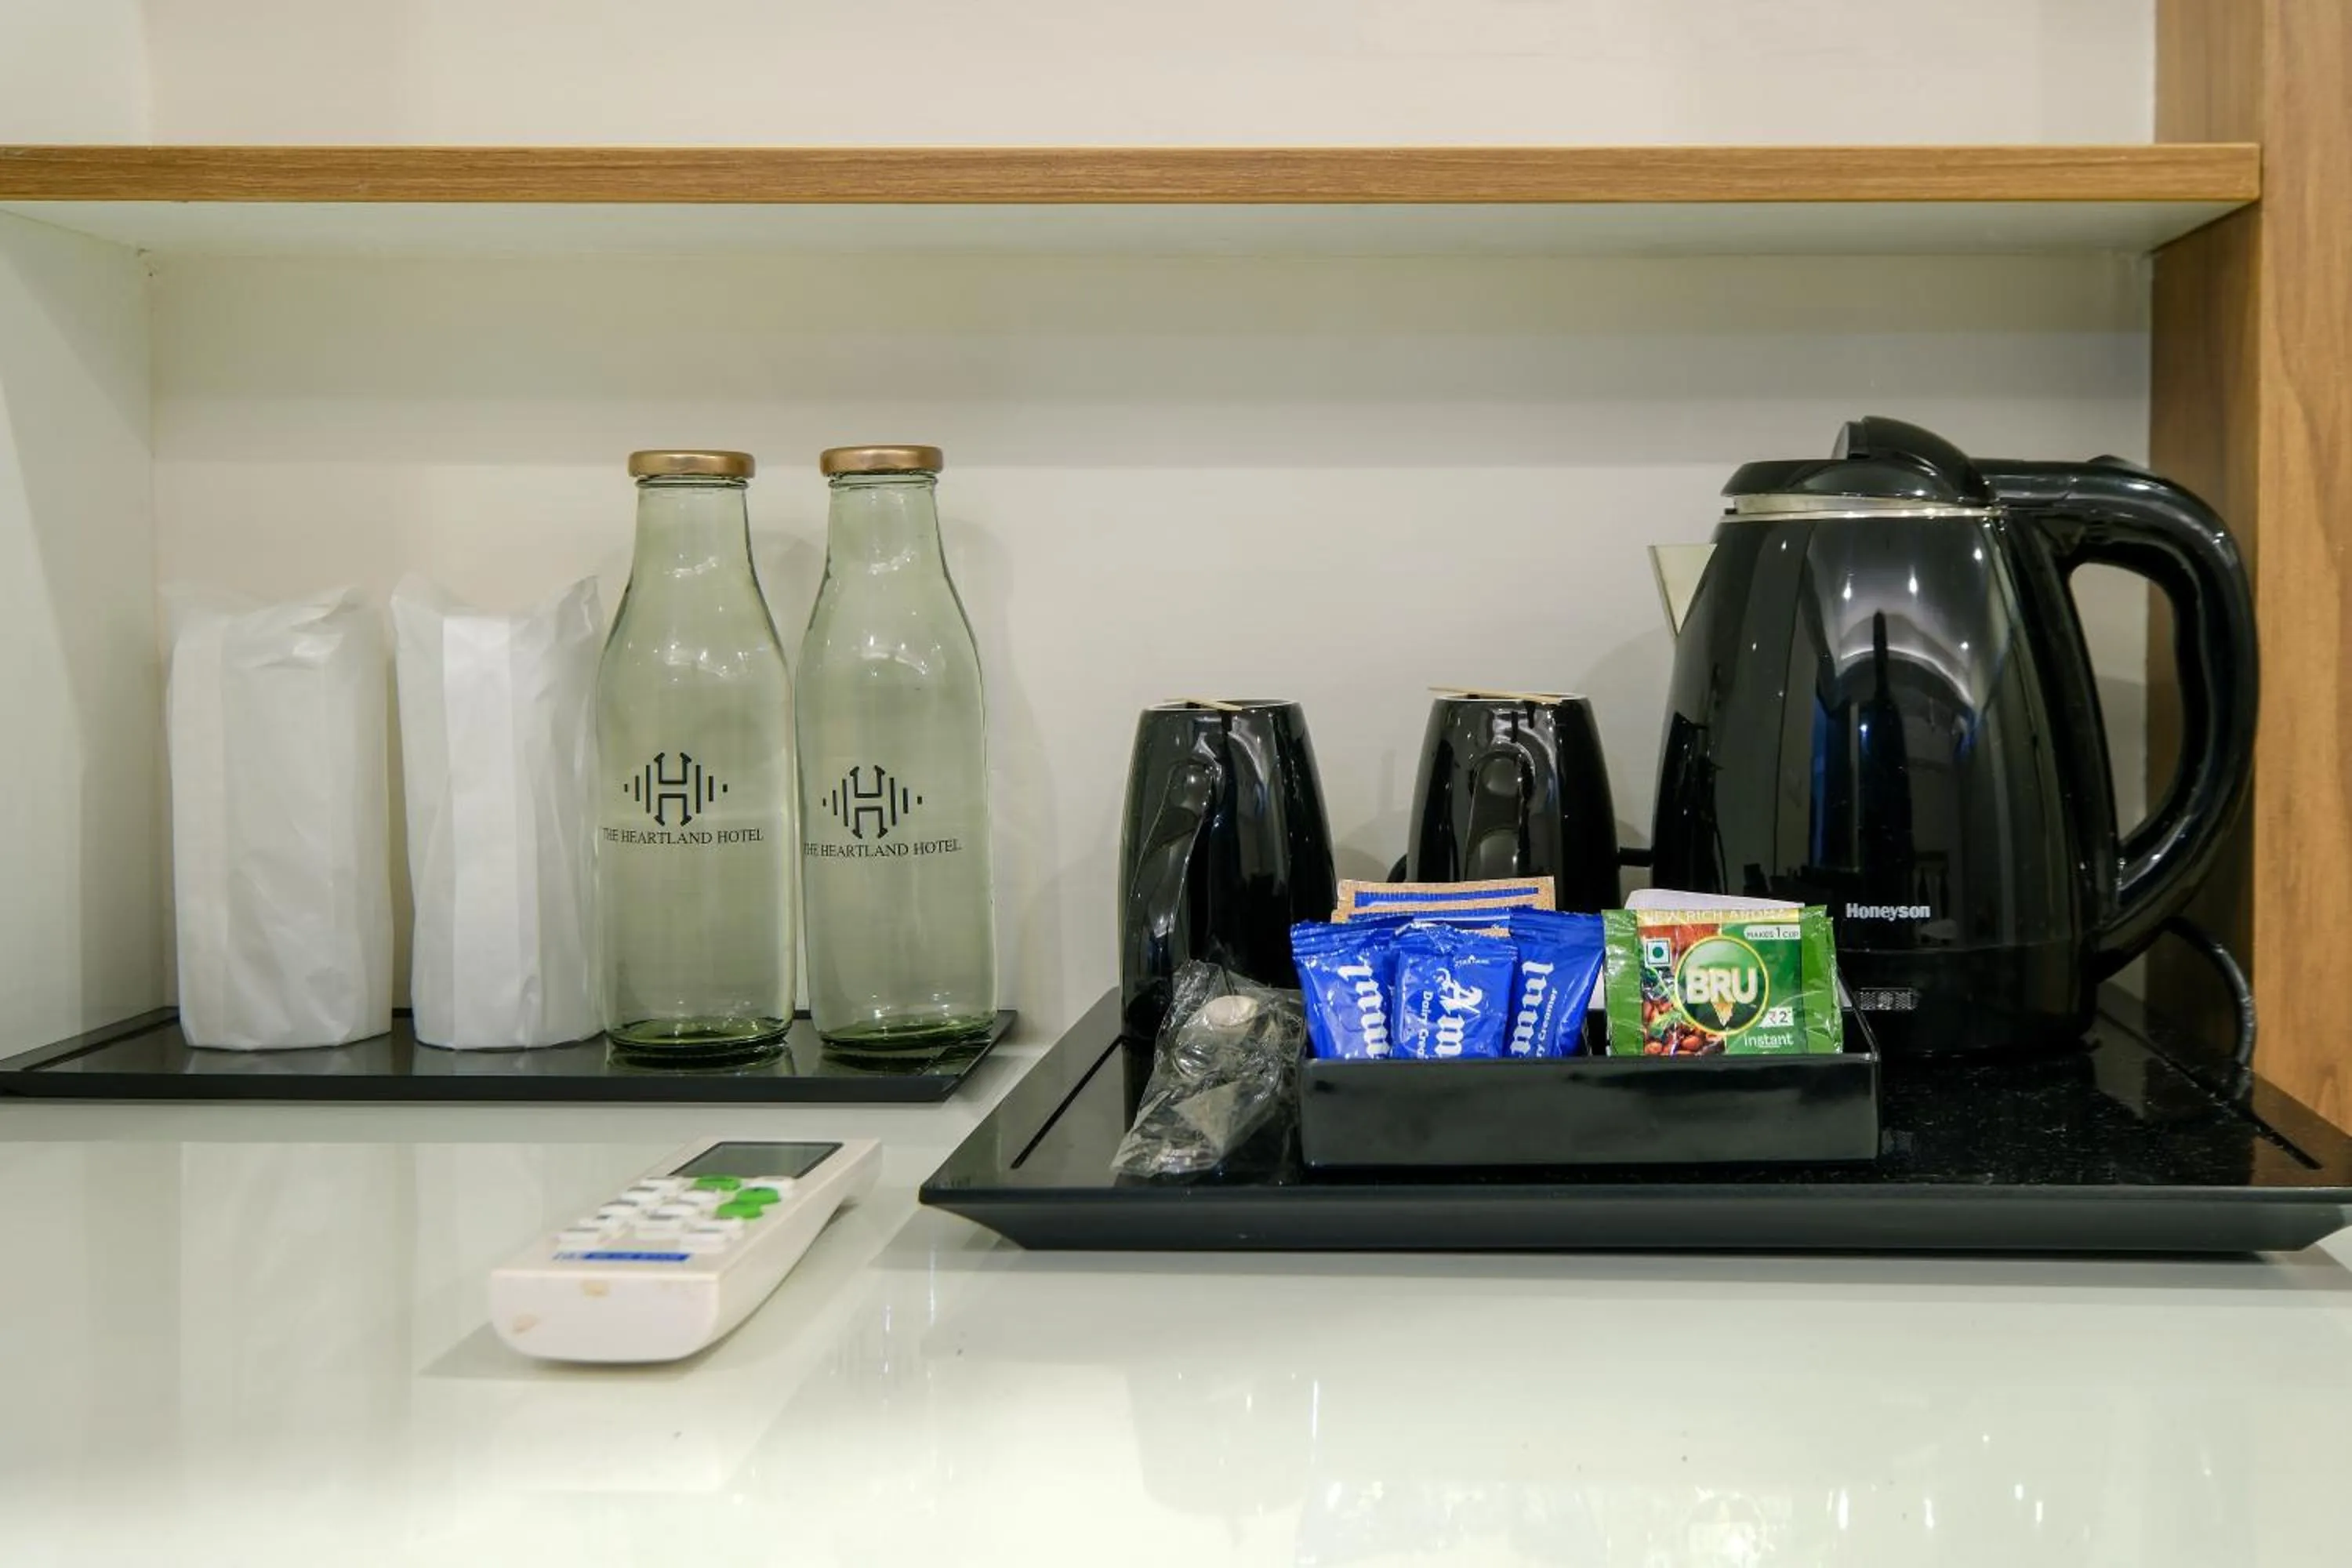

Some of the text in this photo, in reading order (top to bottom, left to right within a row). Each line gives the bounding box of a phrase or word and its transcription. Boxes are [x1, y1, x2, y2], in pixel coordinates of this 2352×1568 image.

[602, 828, 764, 844] THE HEARTLAND HOTEL
[803, 838, 962, 858] THE HEARTLAND HOTEL
[1686, 909, 1723, 922] RICH
[1846, 902, 1931, 922] Honeyson
[1746, 926, 1799, 939] MAKES 1 CUP
[1686, 967, 1759, 1005] BRU
[1336, 964, 1391, 1058] mul
[1417, 990, 1434, 1058] Dairy Crea
[1433, 967, 1483, 1058] Am
[1509, 960, 1554, 1058] mul
[1537, 987, 1558, 1041] Creamer
